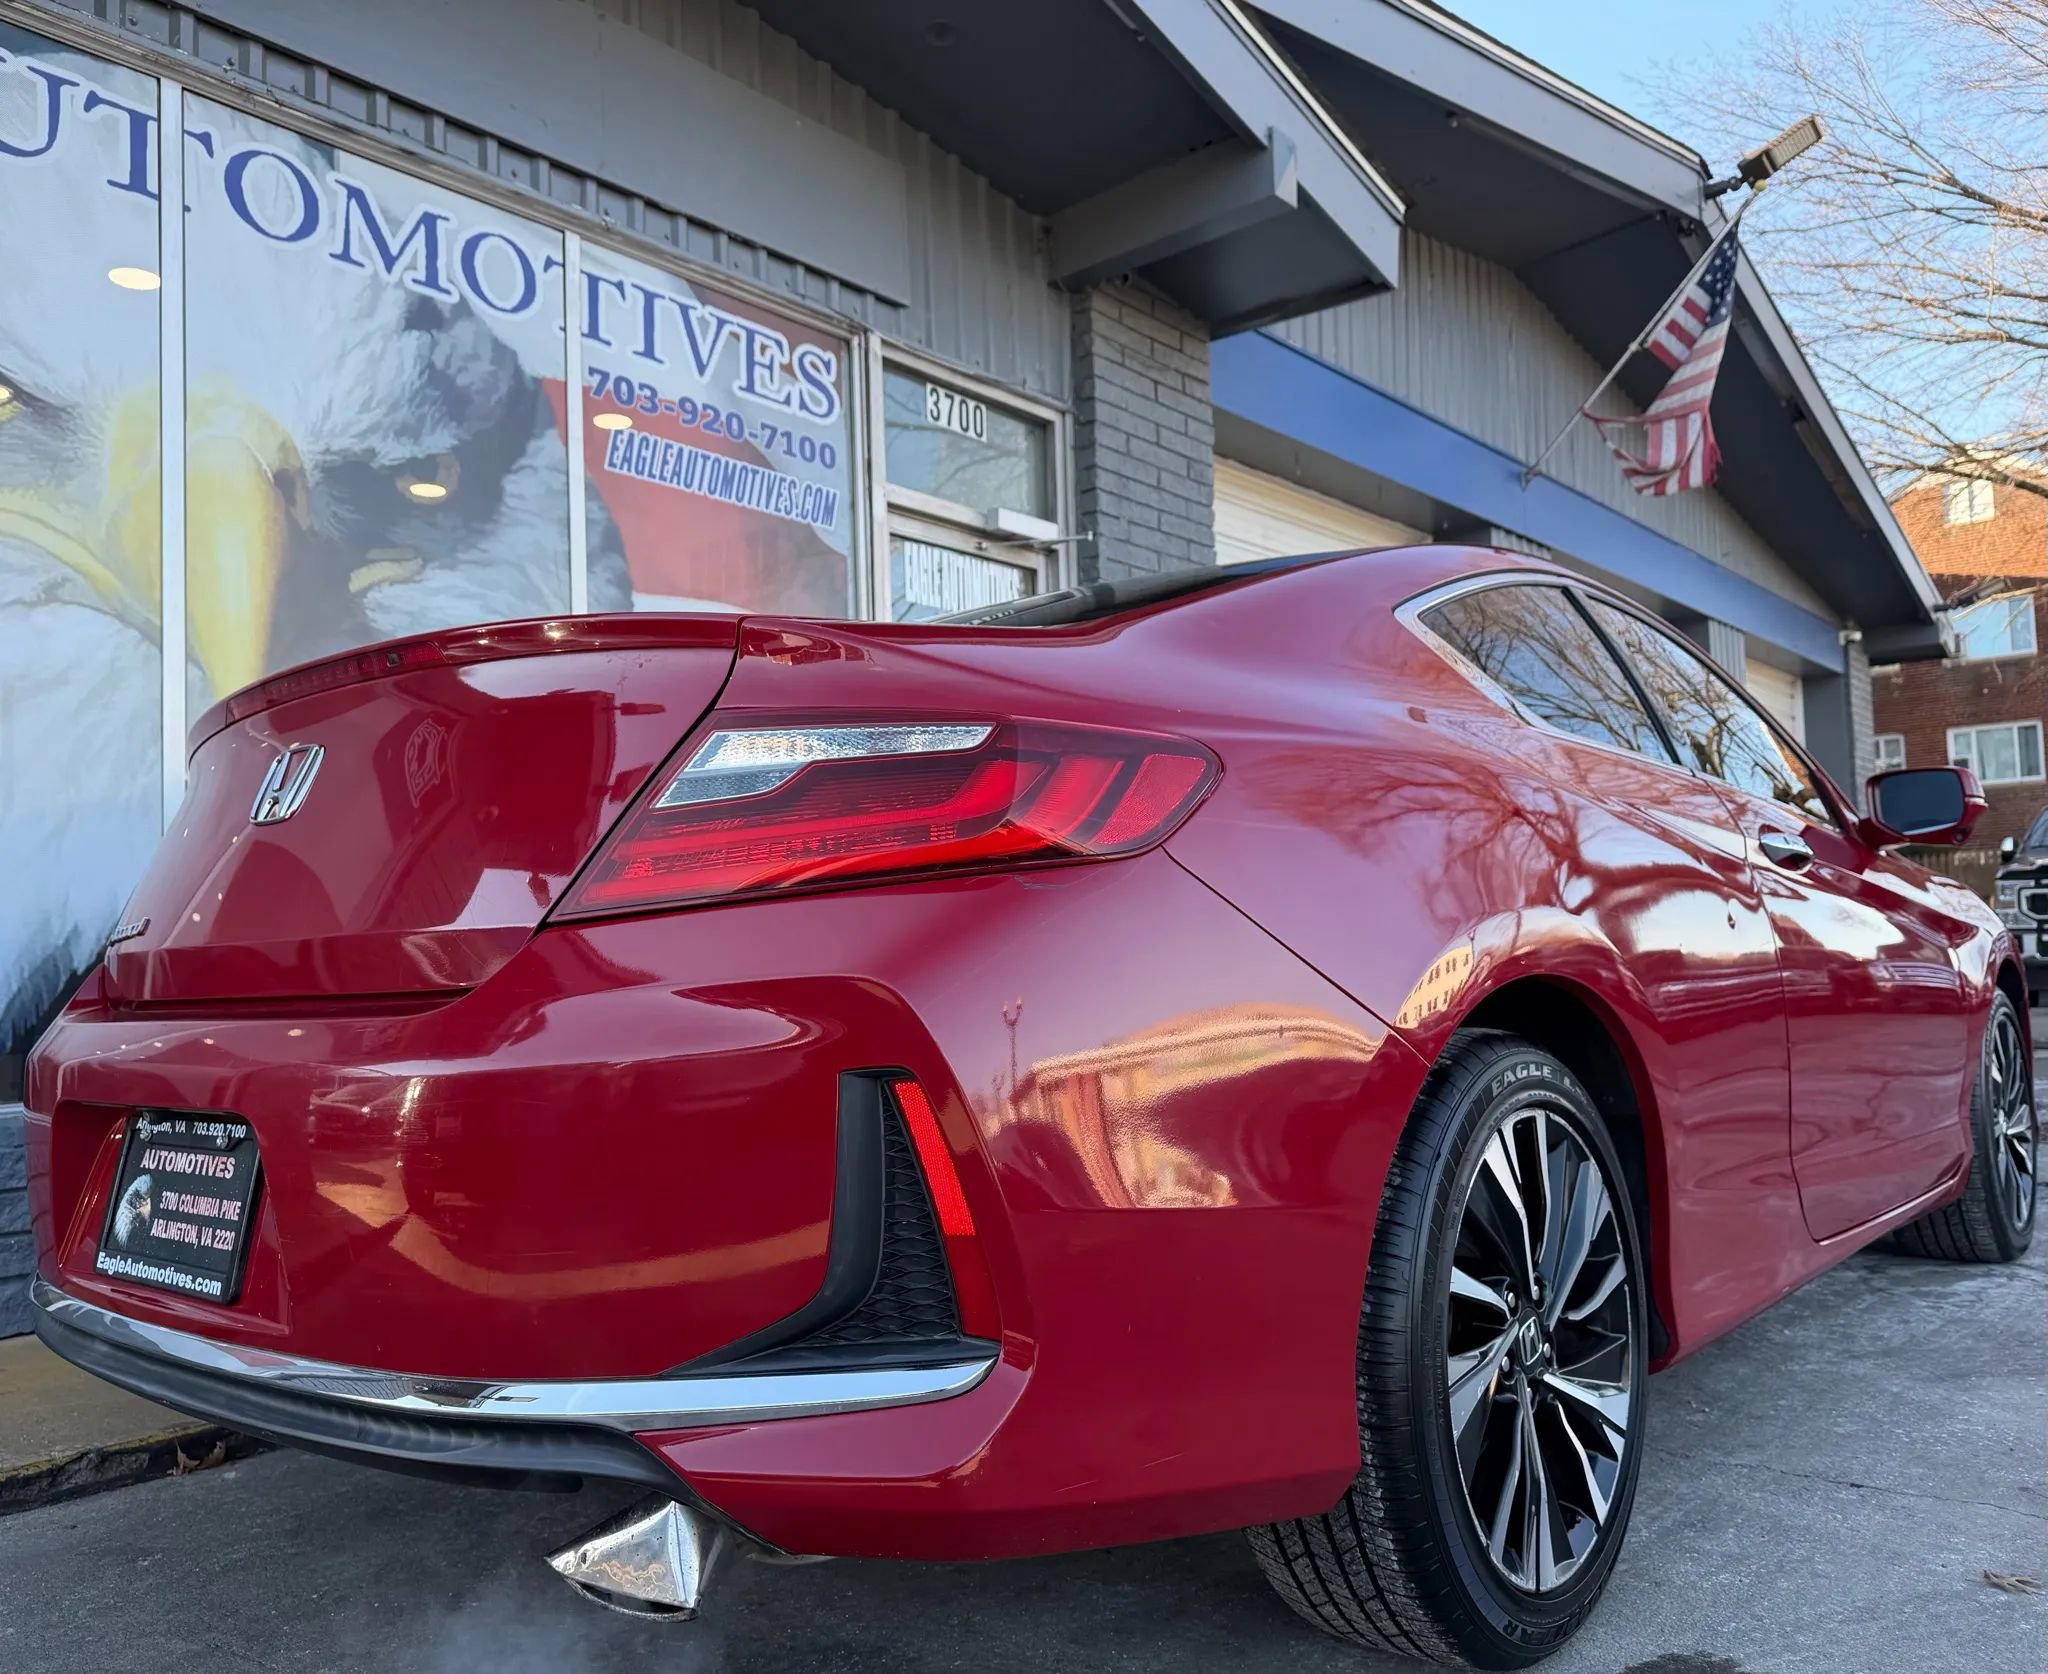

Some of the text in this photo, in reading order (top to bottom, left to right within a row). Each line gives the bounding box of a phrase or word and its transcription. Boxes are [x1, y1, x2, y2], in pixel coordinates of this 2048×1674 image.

[588, 366, 836, 469] 703-920-7100
[929, 387, 985, 439] 3700
[606, 428, 838, 528] EAGLEAUTOMOTIVES.COM
[1491, 1063, 1553, 1097] EAGLE
[174, 1120, 186, 1134] VA
[192, 1121, 247, 1139] 703.920.7100
[140, 1148, 236, 1180] AUTOMOTIVES
[178, 1193, 220, 1218] COLUMBIA
[219, 1199, 242, 1221] PIKE
[150, 1217, 199, 1249] ARLINGTON,
[200, 1226, 213, 1247] VA
[96, 1251, 222, 1296] EagleAutomotives.com
